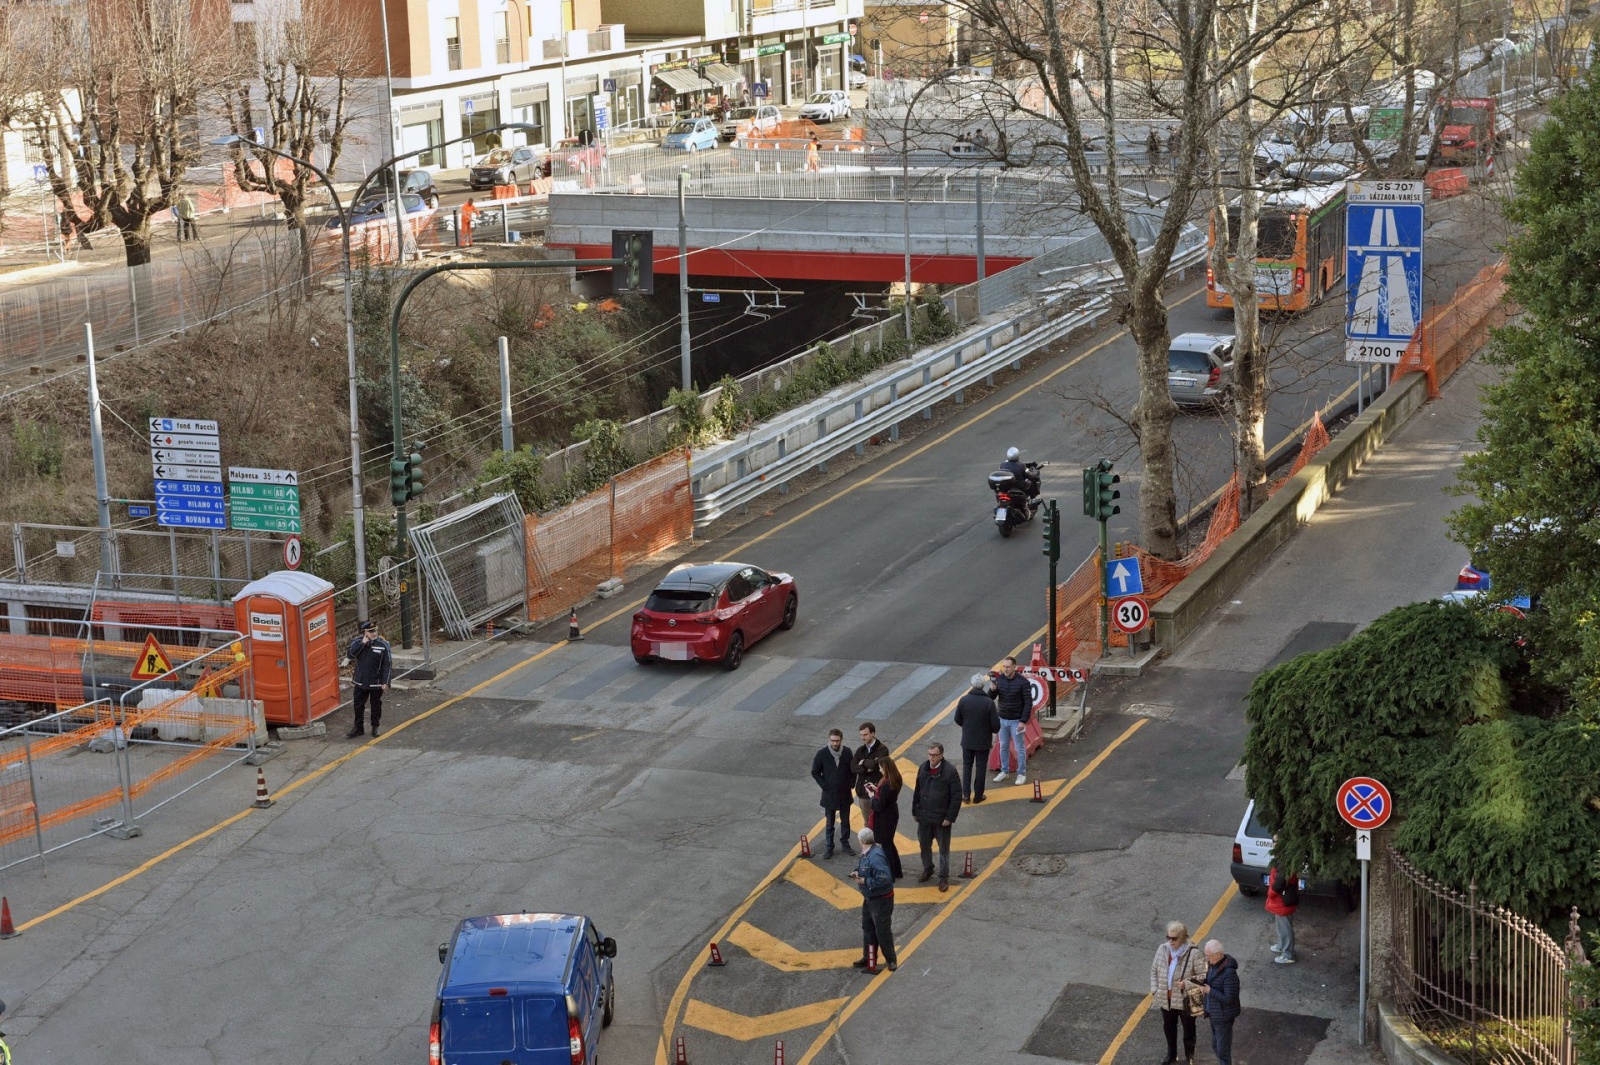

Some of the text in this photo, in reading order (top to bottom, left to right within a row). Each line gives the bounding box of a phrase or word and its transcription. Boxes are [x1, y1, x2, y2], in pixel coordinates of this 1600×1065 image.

[1377, 183, 1413, 191] SS 707
[1369, 193, 1421, 201] GAZZADA-VARESE
[1360, 346, 1391, 357] 2700
[195, 423, 216, 431] Macchi
[230, 471, 272, 480] Malpensa 35
[182, 483, 201, 493] SESTO
[204, 485, 211, 493] C.
[213, 485, 221, 494] 21
[231, 486, 254, 494] MILANO
[275, 489, 284, 498] A8
[214, 501, 222, 509] 41
[214, 516, 223, 525] 48
[277, 520, 286, 528] A9
[1120, 605, 1142, 623] 30
[253, 616, 280, 625] Boels
[309, 617, 327, 631] Boels
[1050, 669, 1082, 679] TORO
